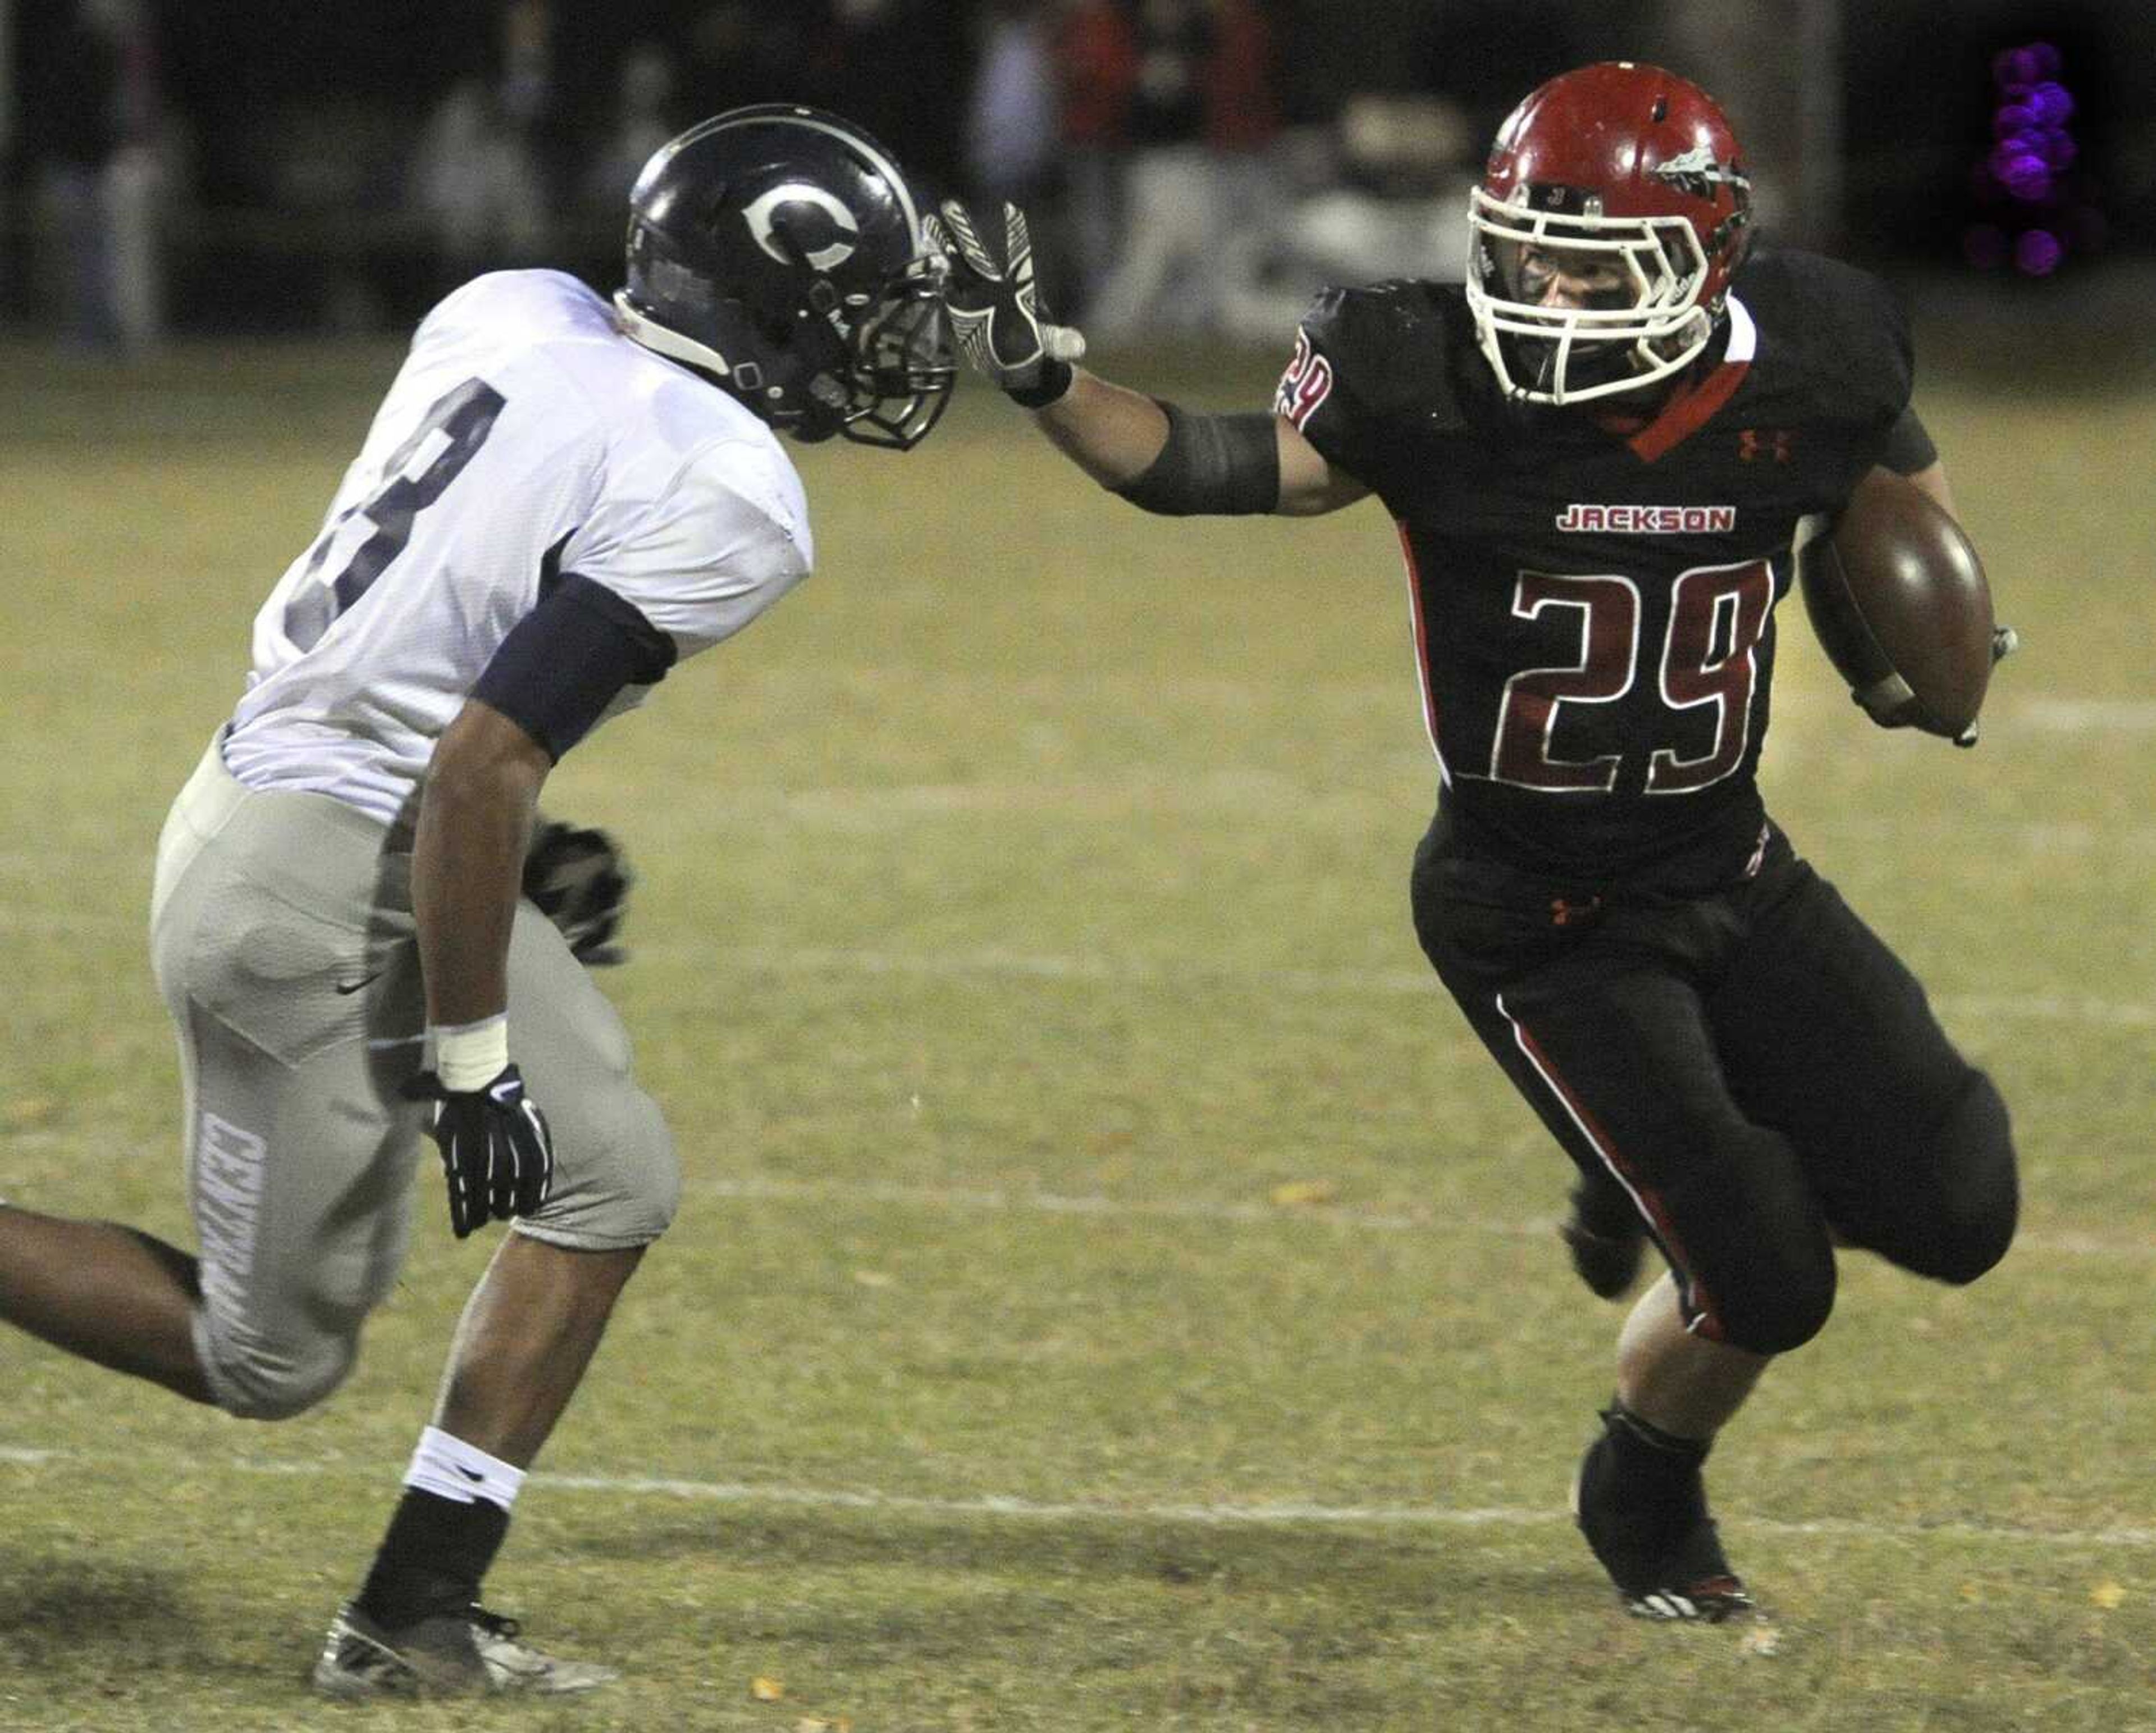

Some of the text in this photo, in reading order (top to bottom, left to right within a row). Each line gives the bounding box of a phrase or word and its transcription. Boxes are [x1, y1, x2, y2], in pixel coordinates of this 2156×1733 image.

[741, 183, 859, 271] C
[1556, 504, 1736, 533] JACKSON
[1490, 559, 1774, 794] 29
